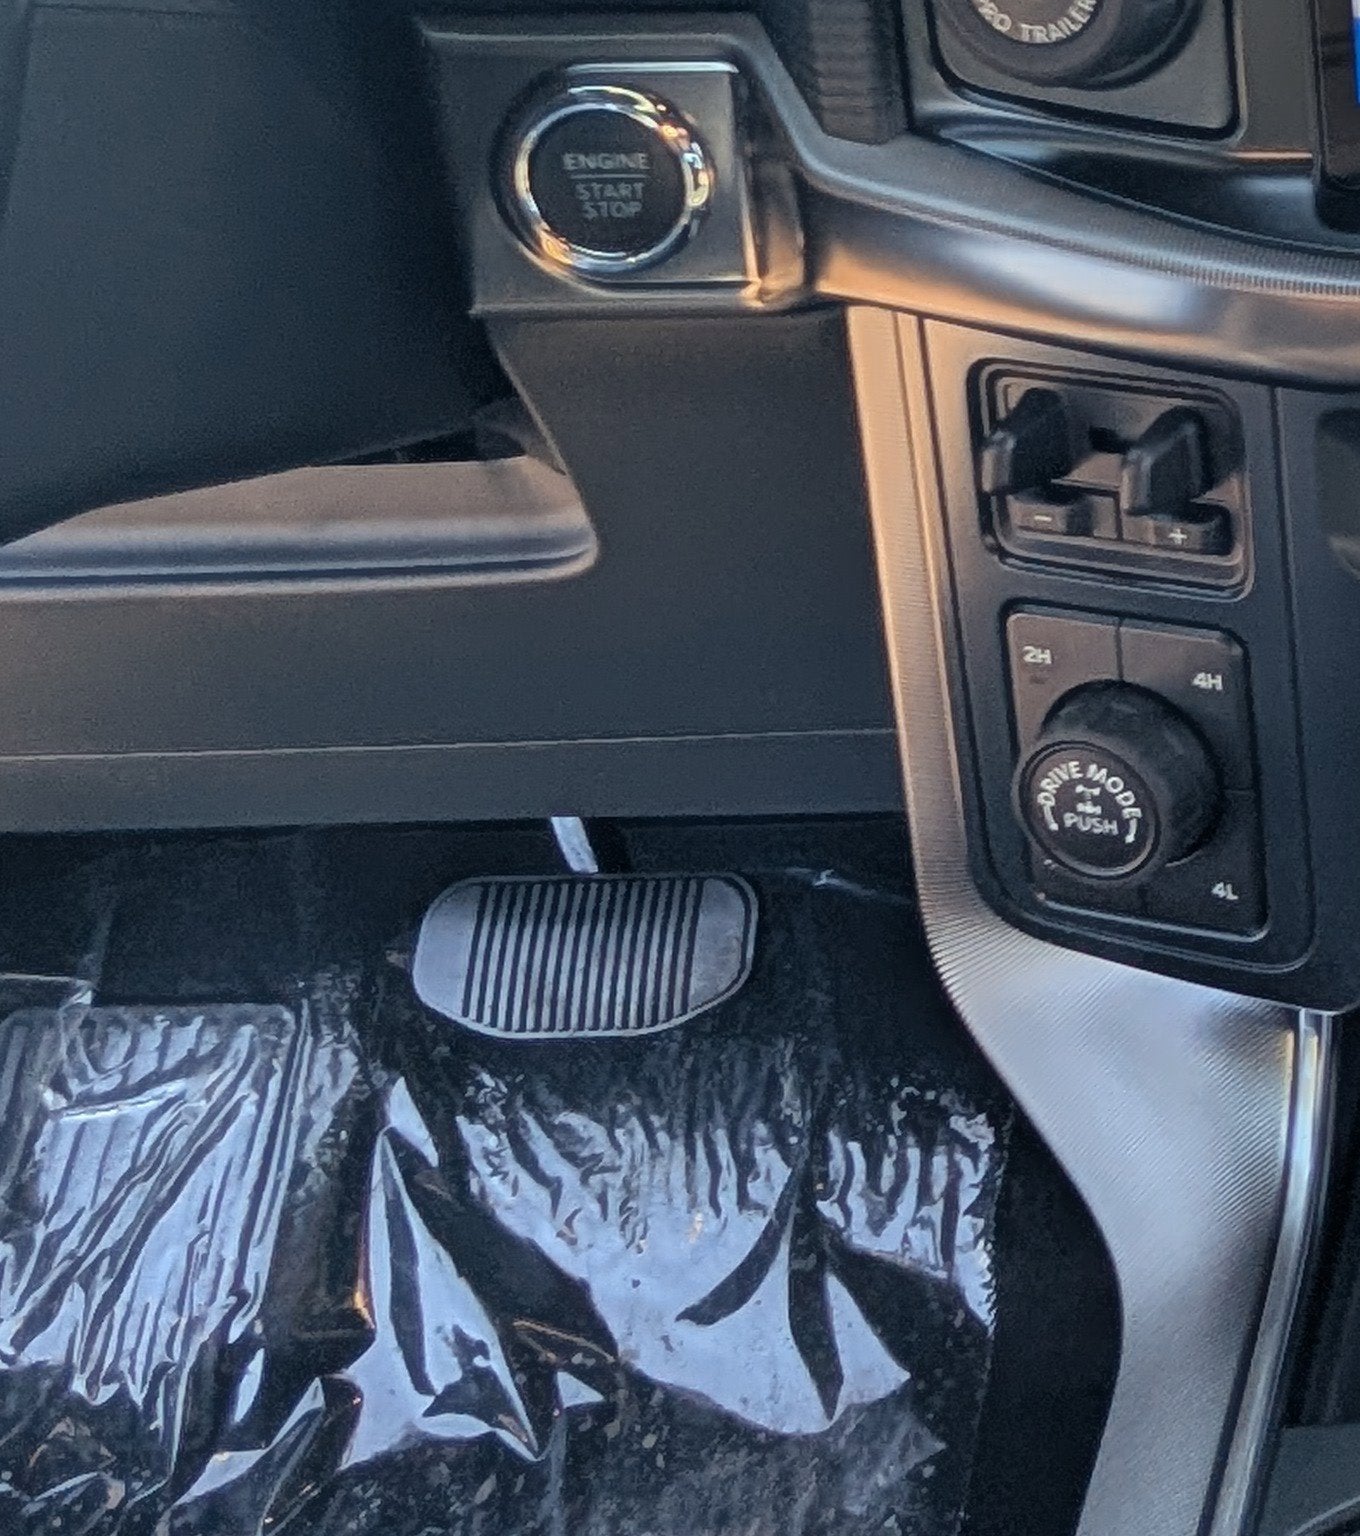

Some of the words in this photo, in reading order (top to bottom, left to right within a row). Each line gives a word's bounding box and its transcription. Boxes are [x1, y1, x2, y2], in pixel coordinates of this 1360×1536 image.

[562, 152, 651, 170] ENGINE
[574, 181, 645, 199] START
[582, 201, 643, 219] STOP
[1022, 645, 1053, 665] 2H
[1191, 671, 1224, 691] 4H
[1036, 760, 1083, 808] DRIVE
[1086, 763, 1143, 820] MODE
[1063, 811, 1119, 836] PUSH
[1211, 882, 1239, 901] 4L
